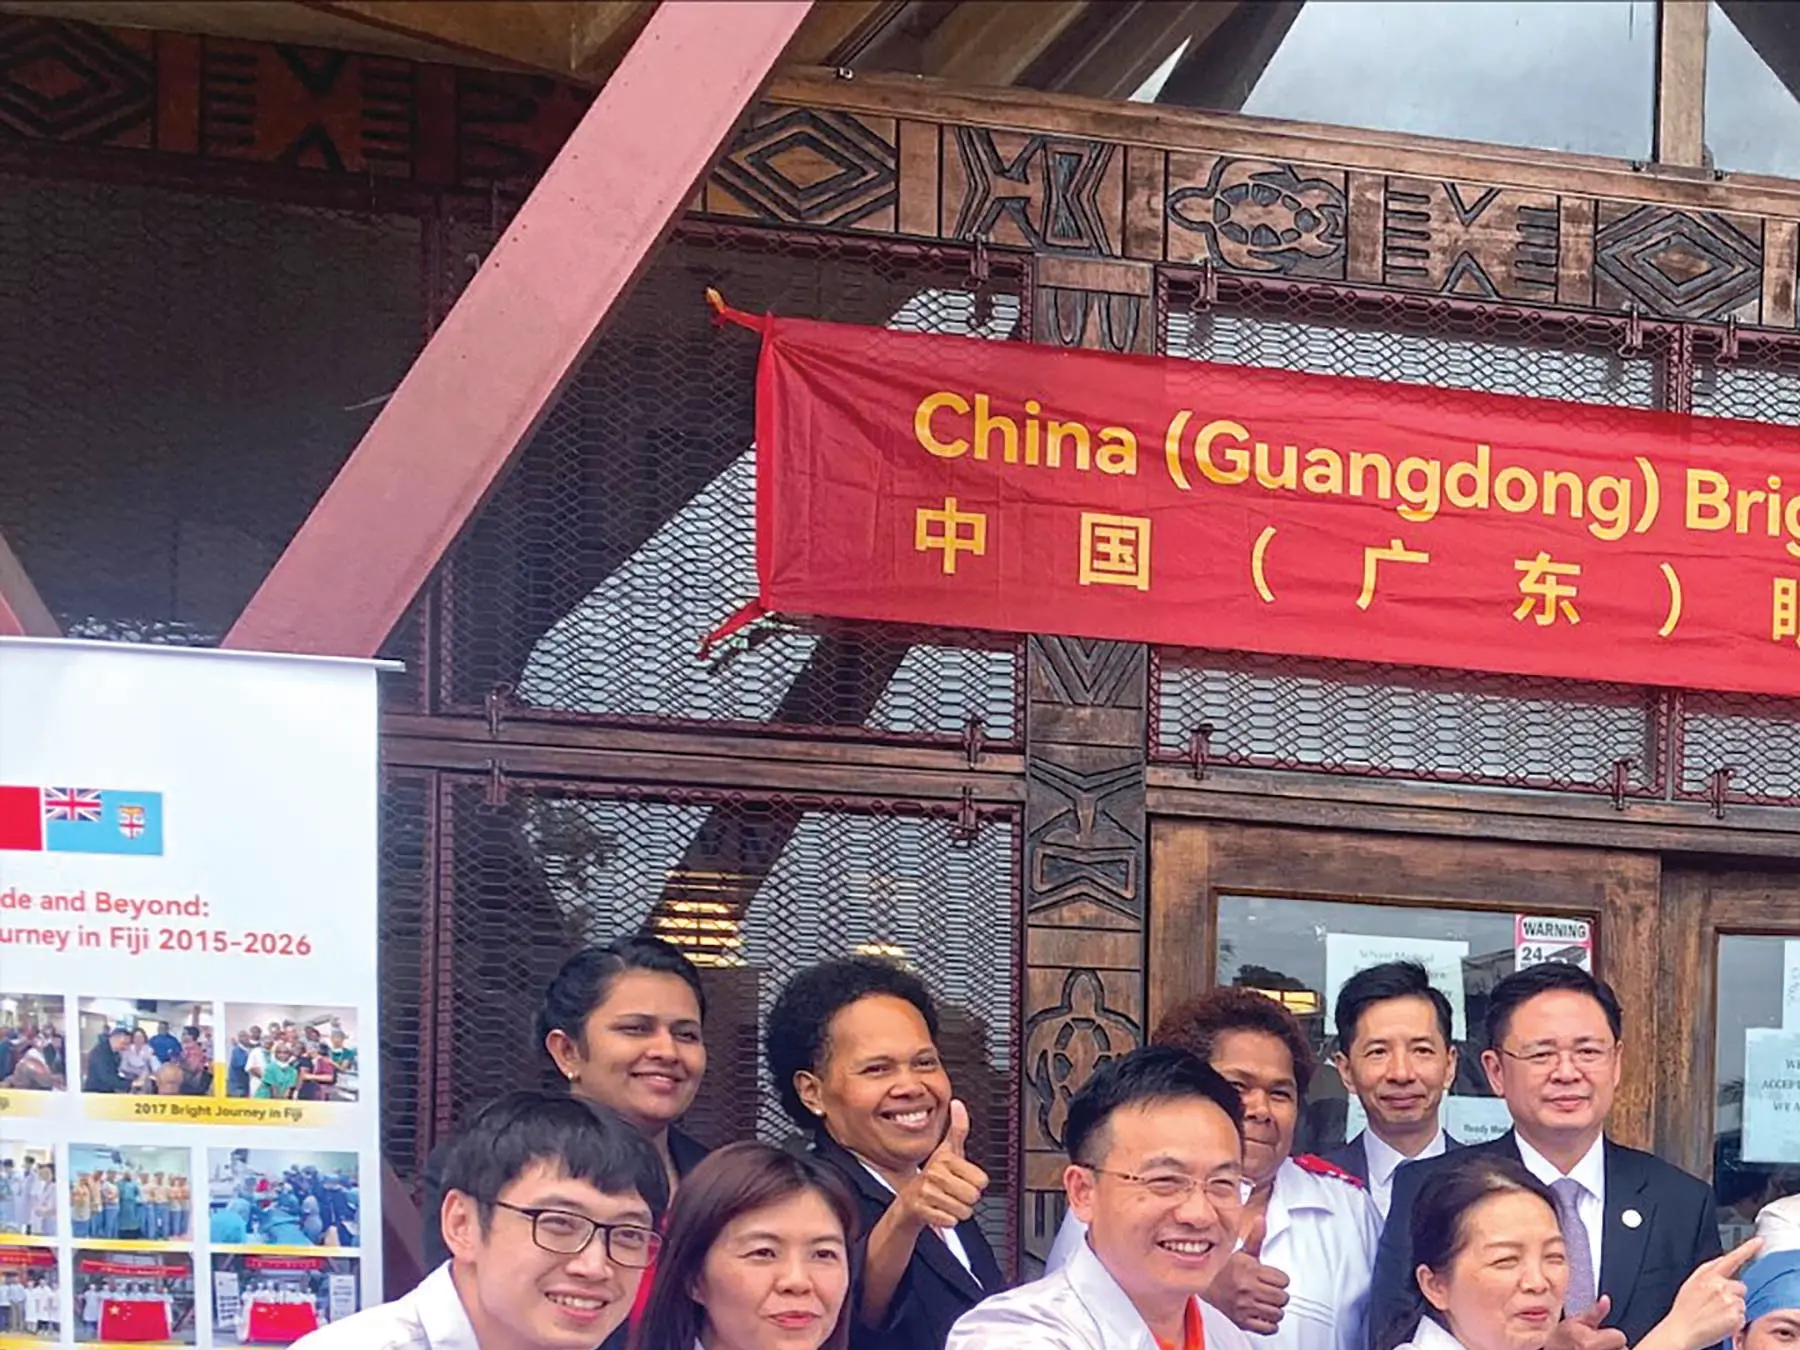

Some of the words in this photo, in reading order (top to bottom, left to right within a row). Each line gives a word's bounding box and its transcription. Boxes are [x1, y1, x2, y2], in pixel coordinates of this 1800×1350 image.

[914, 391, 1138, 476] China
[1165, 408, 1660, 541] (Guangdong)
[40, 891, 85, 912] and
[95, 891, 210, 920] Beyond:
[78, 925, 101, 947] in
[110, 926, 150, 955] Fiji
[1523, 920, 1586, 939] WARNING
[1522, 947, 1543, 961] 24
[134, 1102, 167, 1115] 2017
[170, 1104, 212, 1118] Bright
[215, 1106, 266, 1120] Journey
[268, 1107, 282, 1118] in
